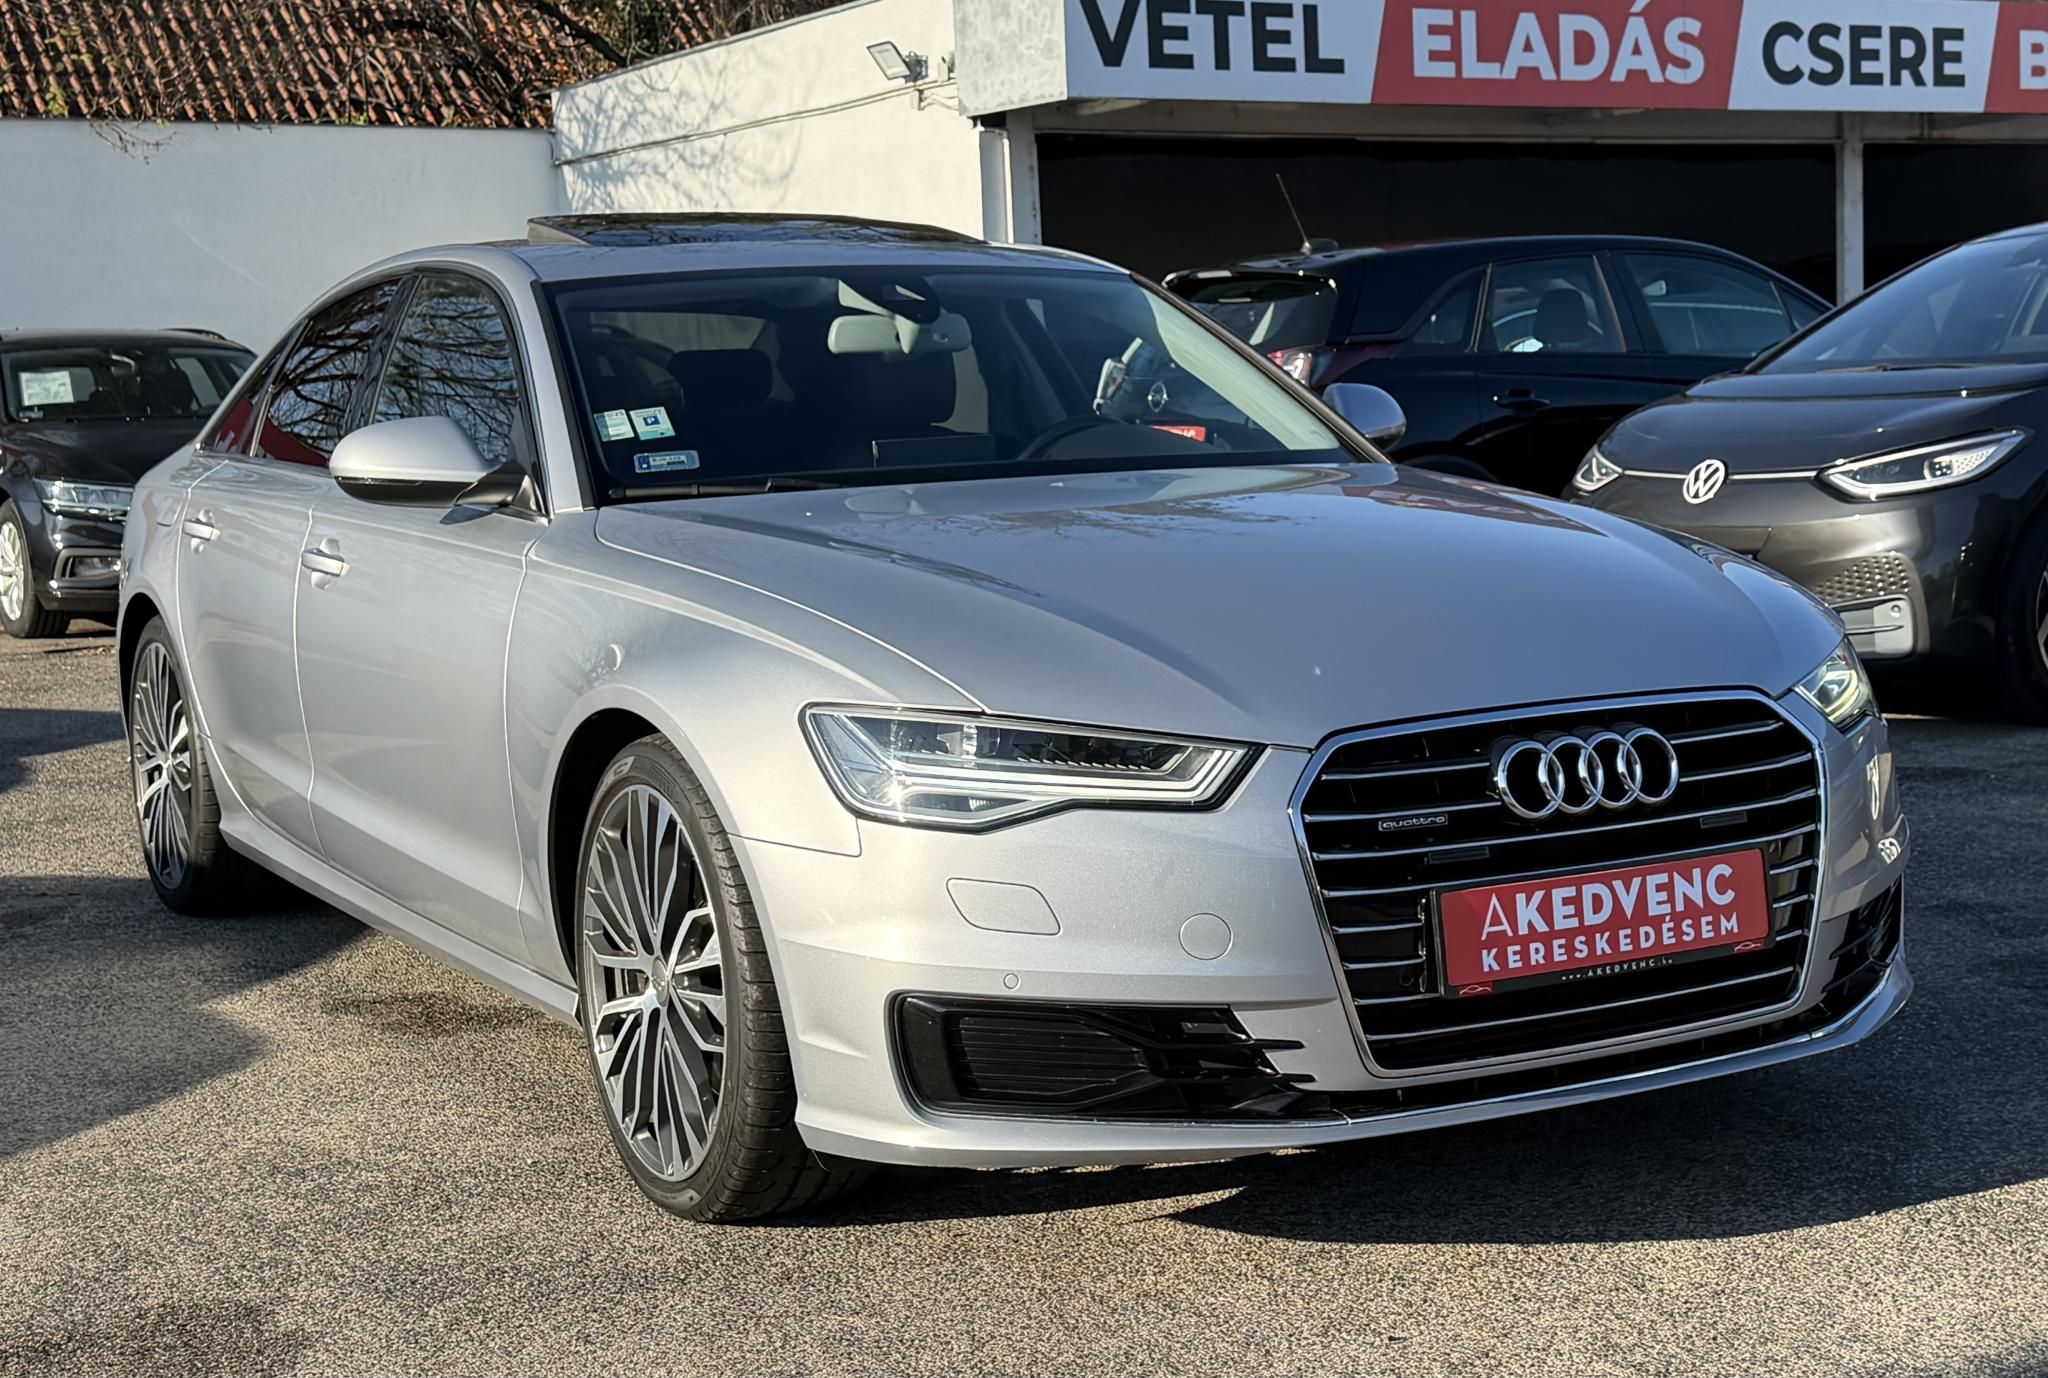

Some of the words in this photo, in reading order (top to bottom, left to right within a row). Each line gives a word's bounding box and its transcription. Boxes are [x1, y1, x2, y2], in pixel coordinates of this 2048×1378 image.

[1411, 0, 1705, 85] ELADÁS
[1761, 20, 1966, 88] CSERE
[1382, 815, 1446, 831] quattro
[1482, 912, 1739, 973] KERESKEDÉSEM
